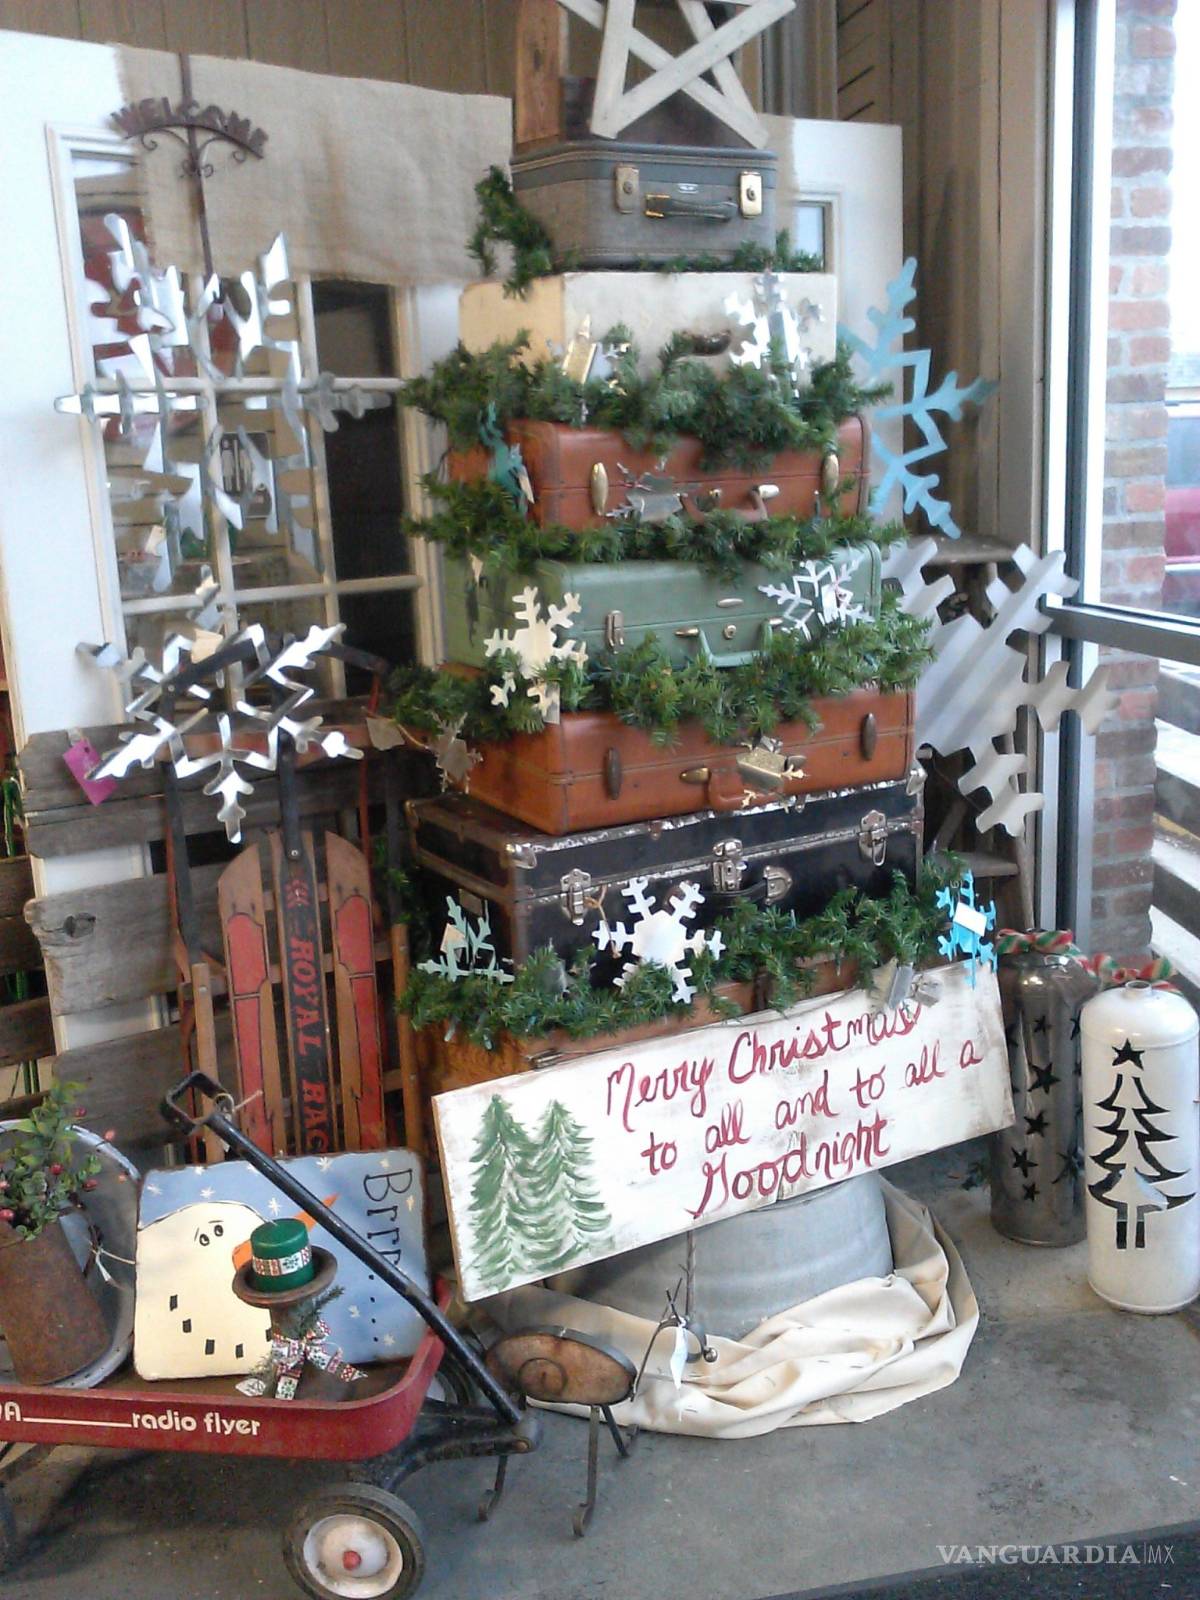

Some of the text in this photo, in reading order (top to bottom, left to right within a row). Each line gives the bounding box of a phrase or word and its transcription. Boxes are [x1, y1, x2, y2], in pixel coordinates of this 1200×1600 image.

[109, 96, 269, 157] WELCOME
[289, 937, 323, 1056] ROYAL
[606, 1002, 922, 1133] Merry Christmas
[640, 1039, 984, 1176] to all and to all a
[131, 1409, 197, 1432] radio
[203, 1412, 261, 1436] flyer
